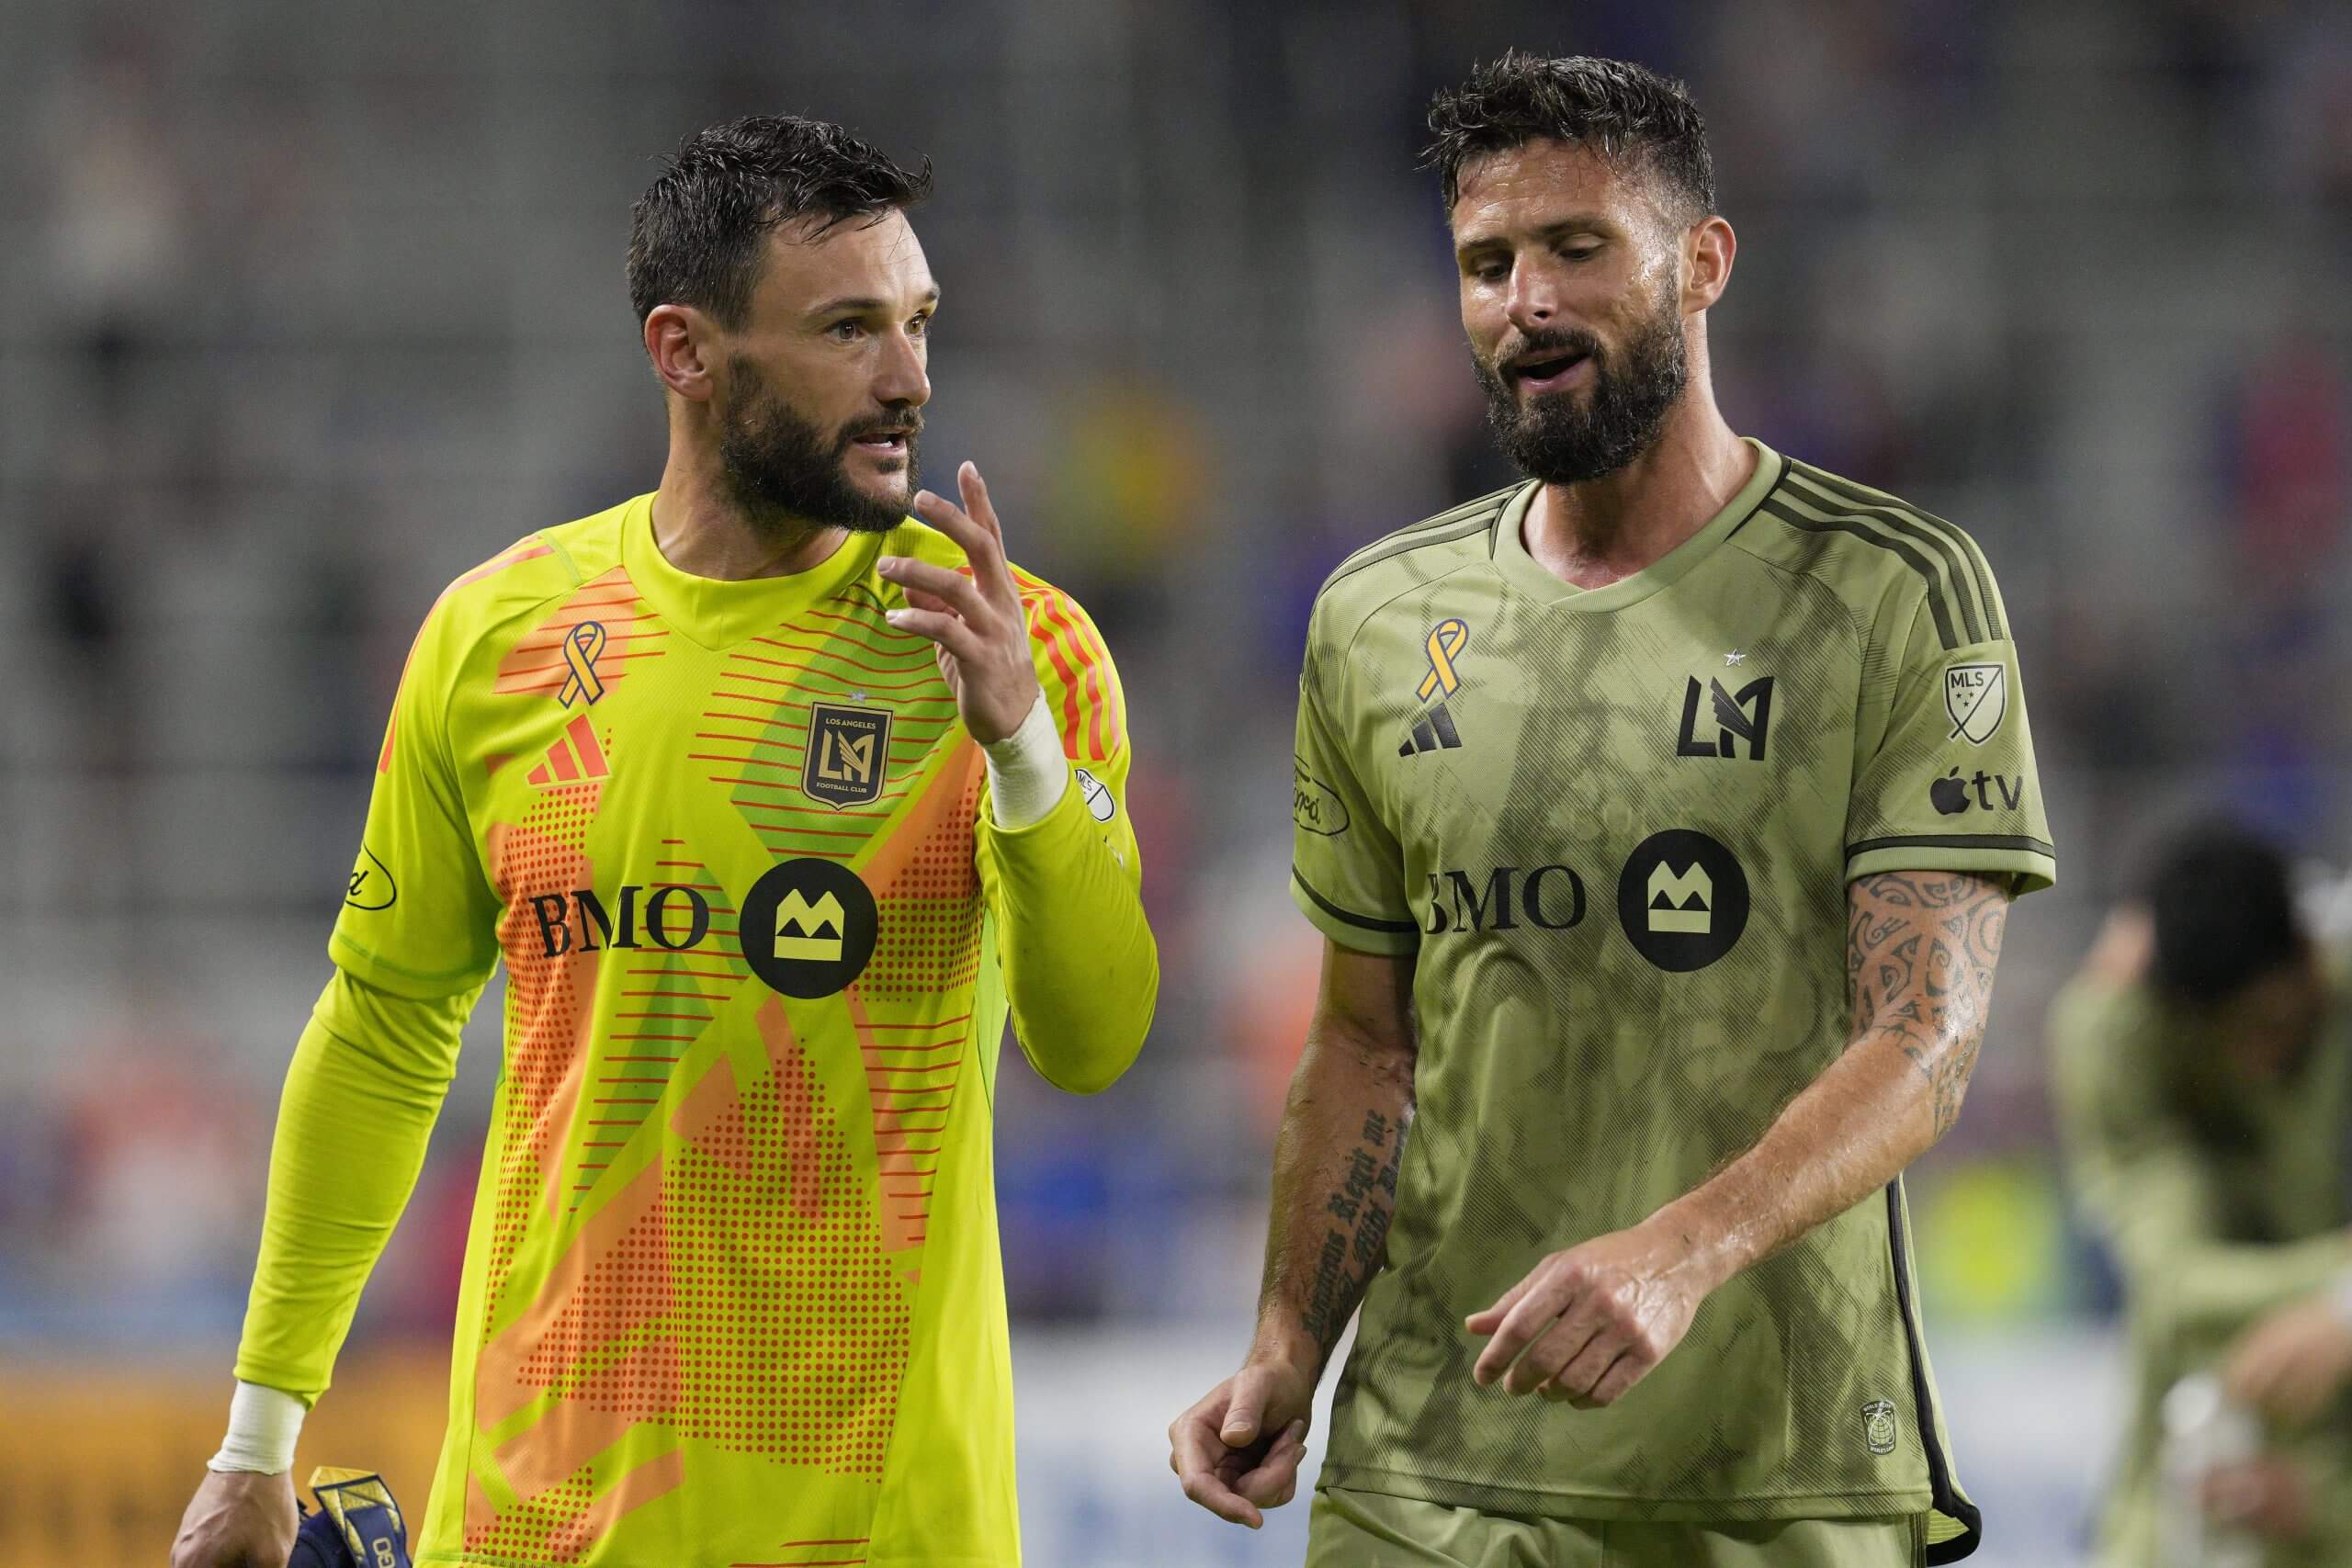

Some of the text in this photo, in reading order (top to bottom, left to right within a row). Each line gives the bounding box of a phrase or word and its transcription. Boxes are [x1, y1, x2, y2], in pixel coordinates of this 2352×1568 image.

[1951, 671, 1984, 688] MLS
[825, 717, 876, 730] LOS ANGELES
[816, 782, 850, 793] FOOTBALL
[1079, 773, 1092, 791] MLS
[1972, 770, 2023, 810] tv
[528, 886, 710, 959] BMO
